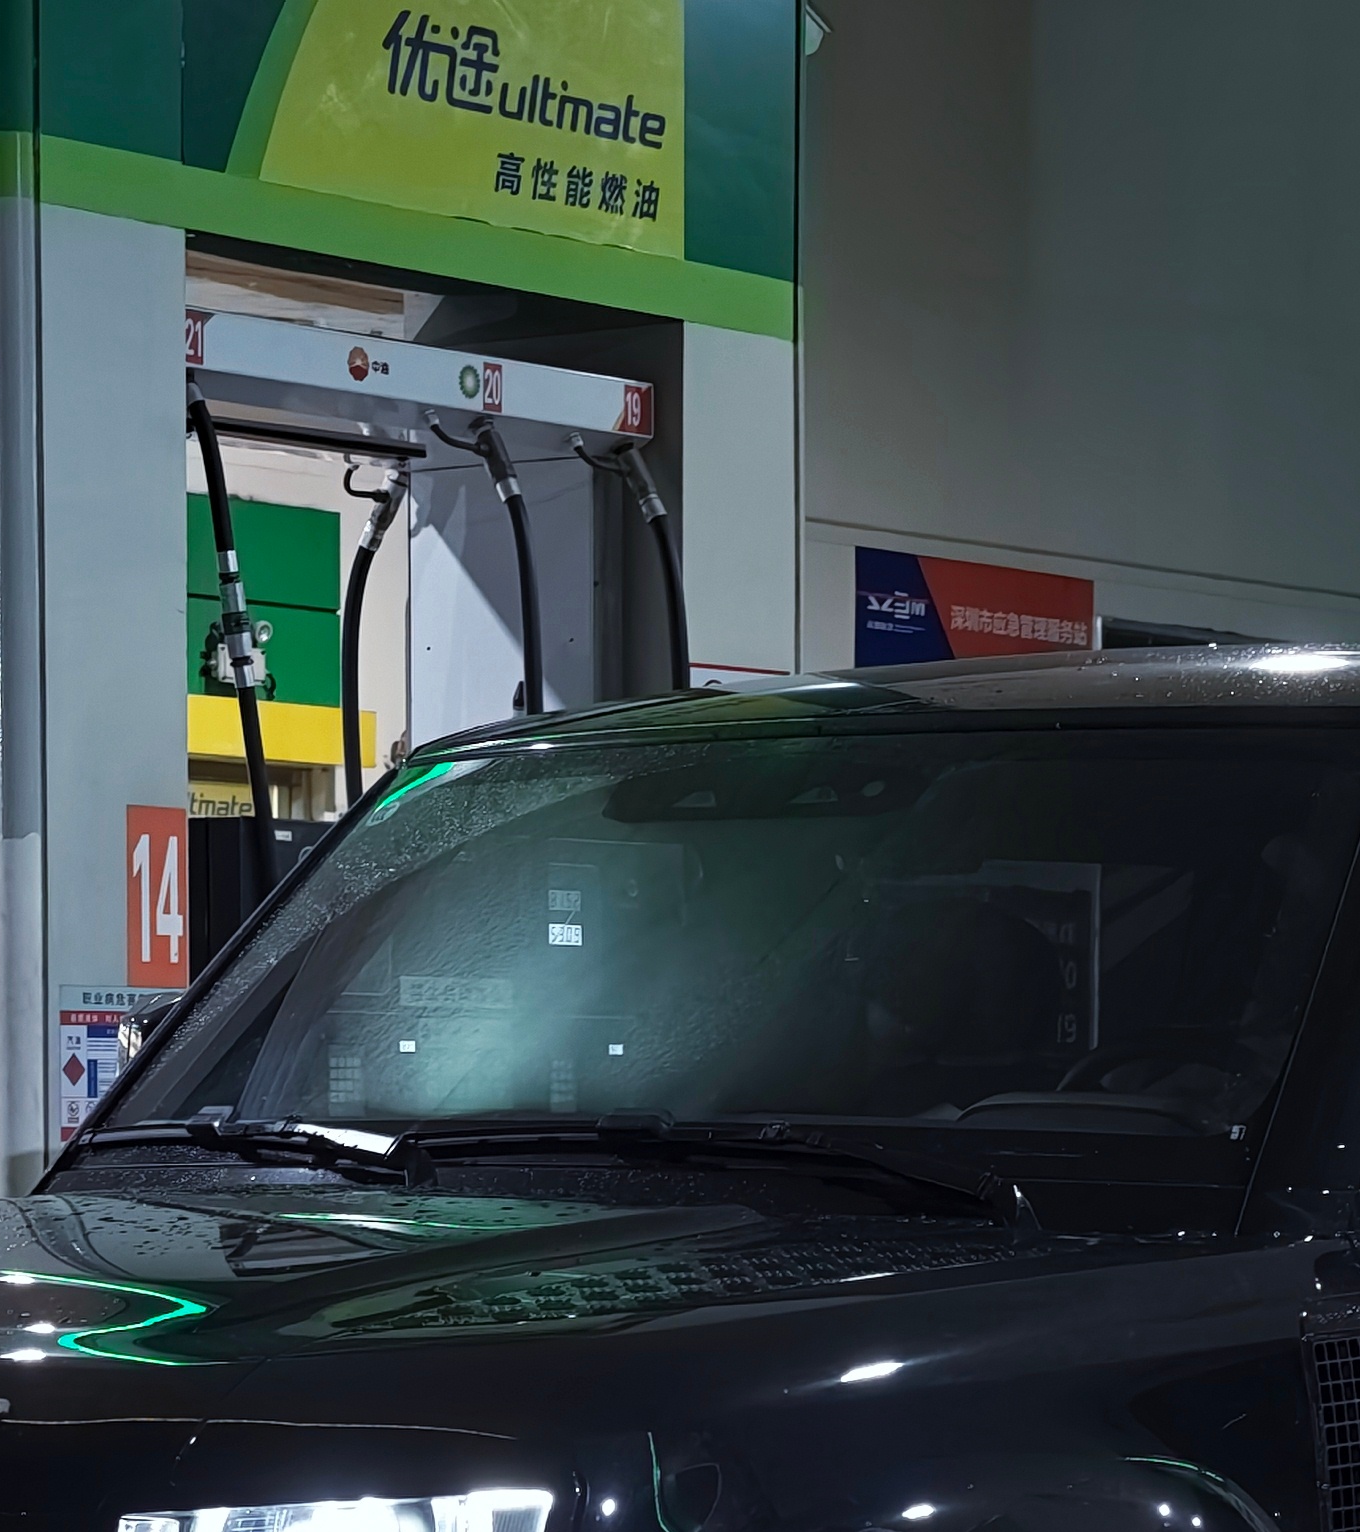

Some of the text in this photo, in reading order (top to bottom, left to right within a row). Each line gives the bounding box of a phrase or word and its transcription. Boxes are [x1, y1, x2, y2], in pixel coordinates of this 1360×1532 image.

[493, 151, 660, 223] 高性能燃油
[485, 369, 502, 406] 20
[625, 391, 642, 427] 19
[950, 604, 1087, 646] 深圳市应急管理服务站
[187, 791, 253, 816] timate
[132, 833, 184, 964] 14
